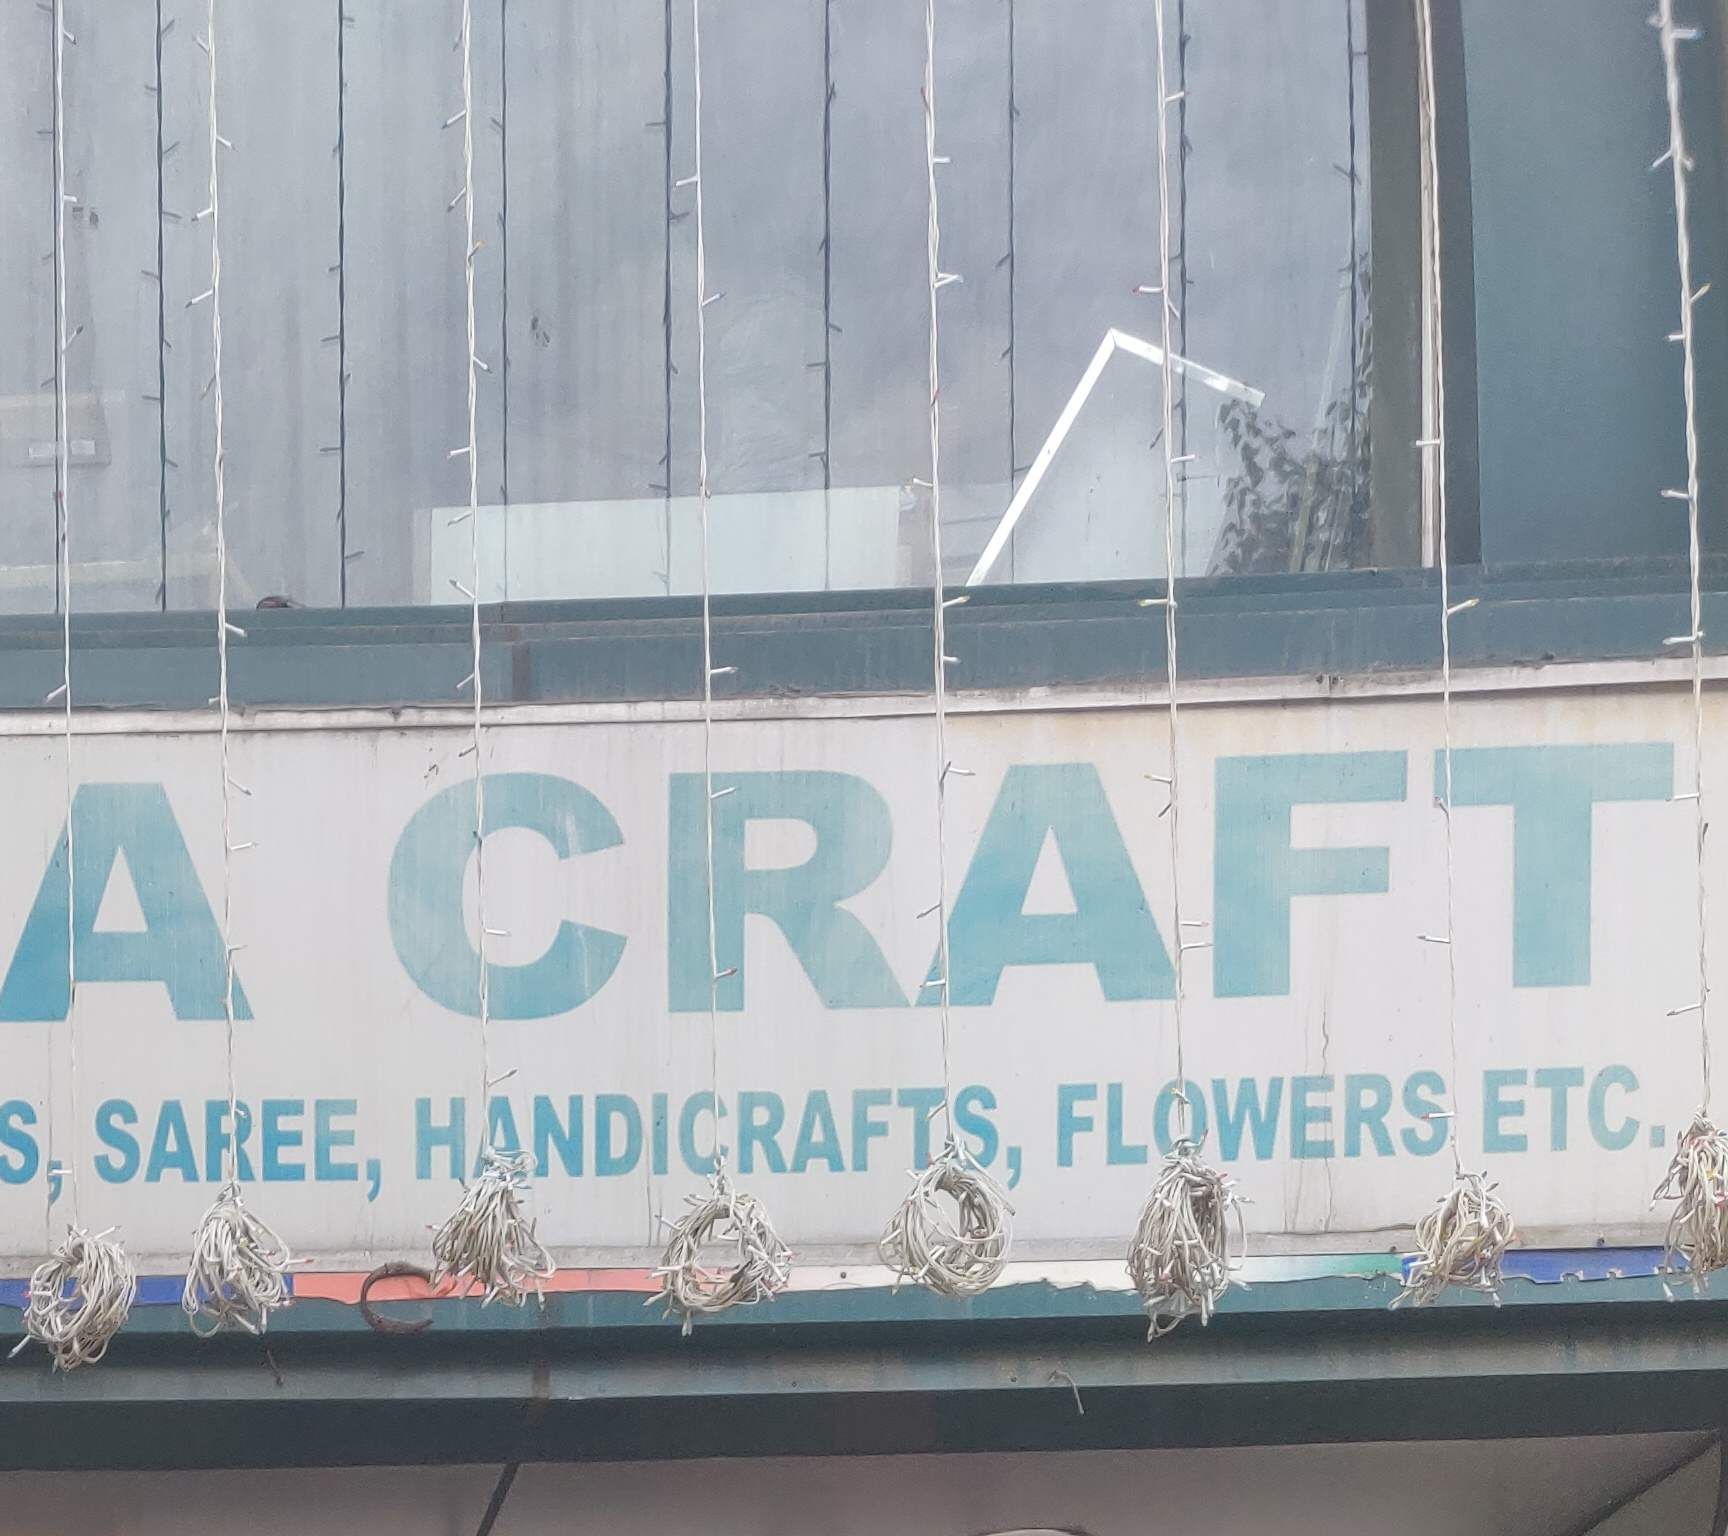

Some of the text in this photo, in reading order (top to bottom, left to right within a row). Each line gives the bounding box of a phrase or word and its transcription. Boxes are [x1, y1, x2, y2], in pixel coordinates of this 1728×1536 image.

[389, 741, 1675, 1019] CRAFT
[94, 1099, 384, 1202] SAREE,
[415, 1085, 1023, 1190] HANDICRAFTS,
[1056, 1073, 1448, 1169] FLOWERS
[1481, 1065, 1667, 1154] ETC.
